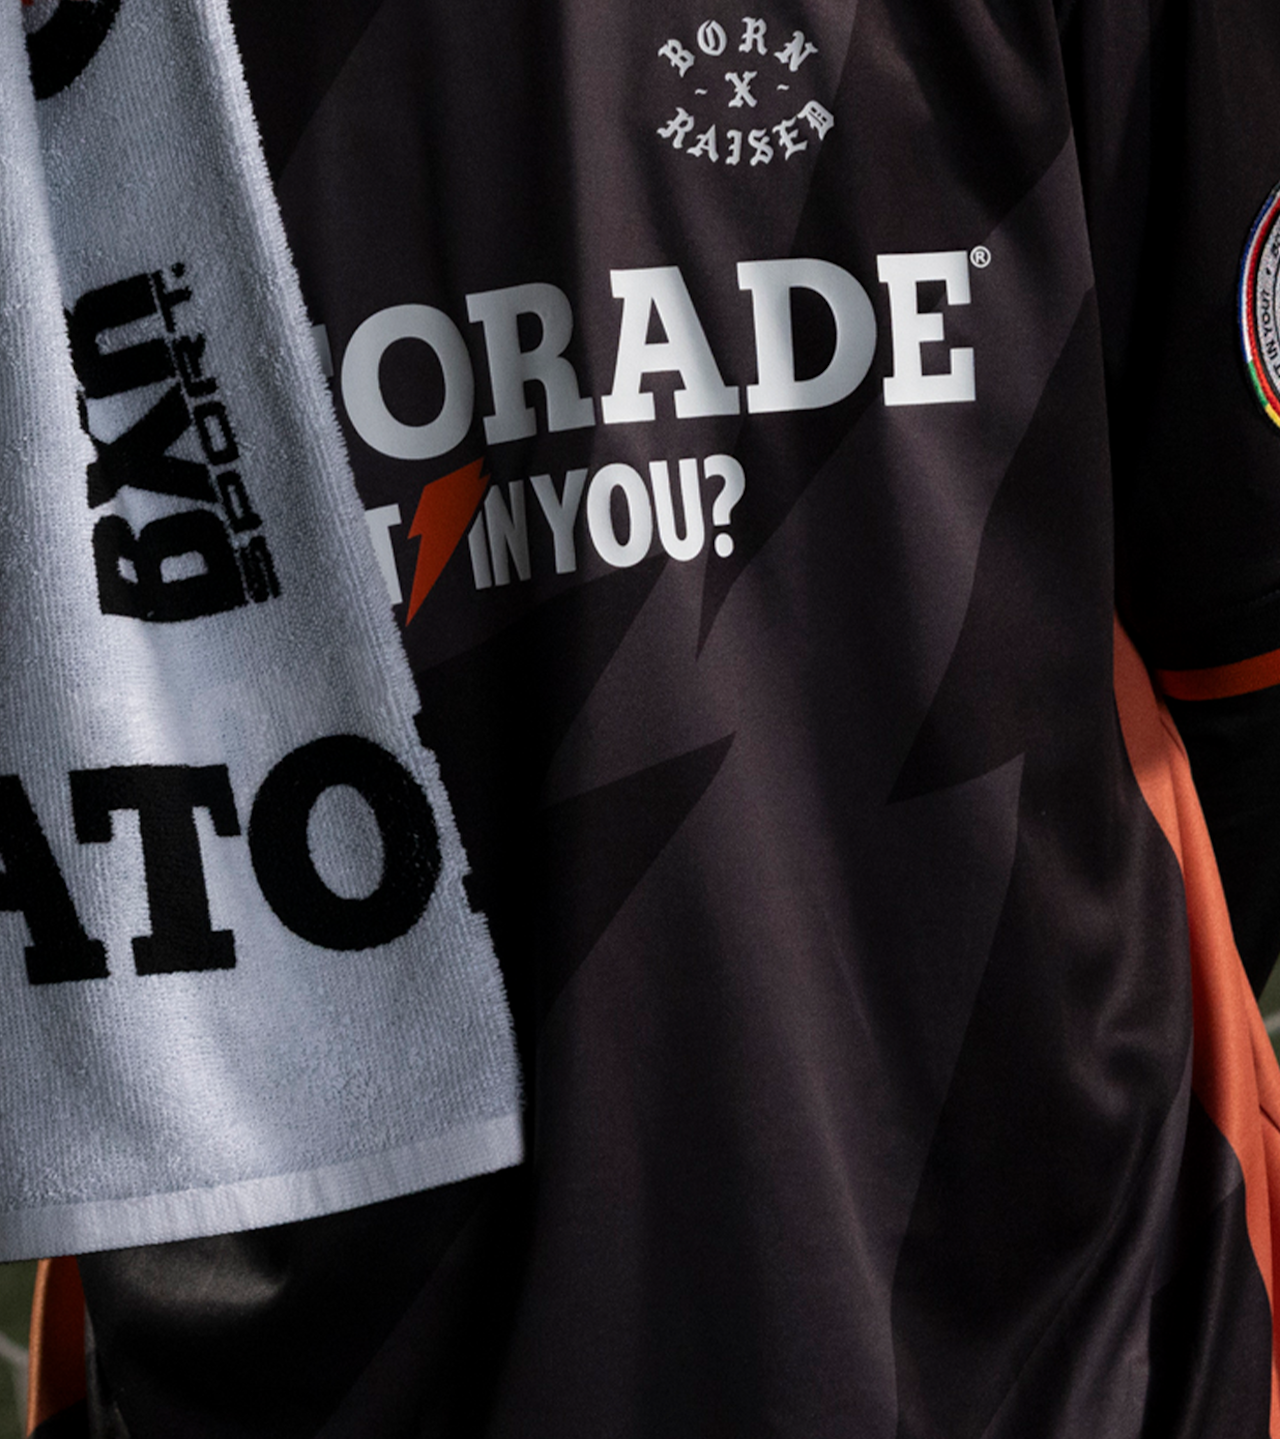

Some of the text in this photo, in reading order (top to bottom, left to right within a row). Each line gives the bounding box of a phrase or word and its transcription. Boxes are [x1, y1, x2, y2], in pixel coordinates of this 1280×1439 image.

[658, 16, 818, 77] BORN
[725, 71, 757, 108] X
[657, 100, 835, 166] RAISED
[315, 247, 991, 460] ORADE®
[1265, 340, 1279, 362] IN
[529, 454, 746, 576] YOU?
